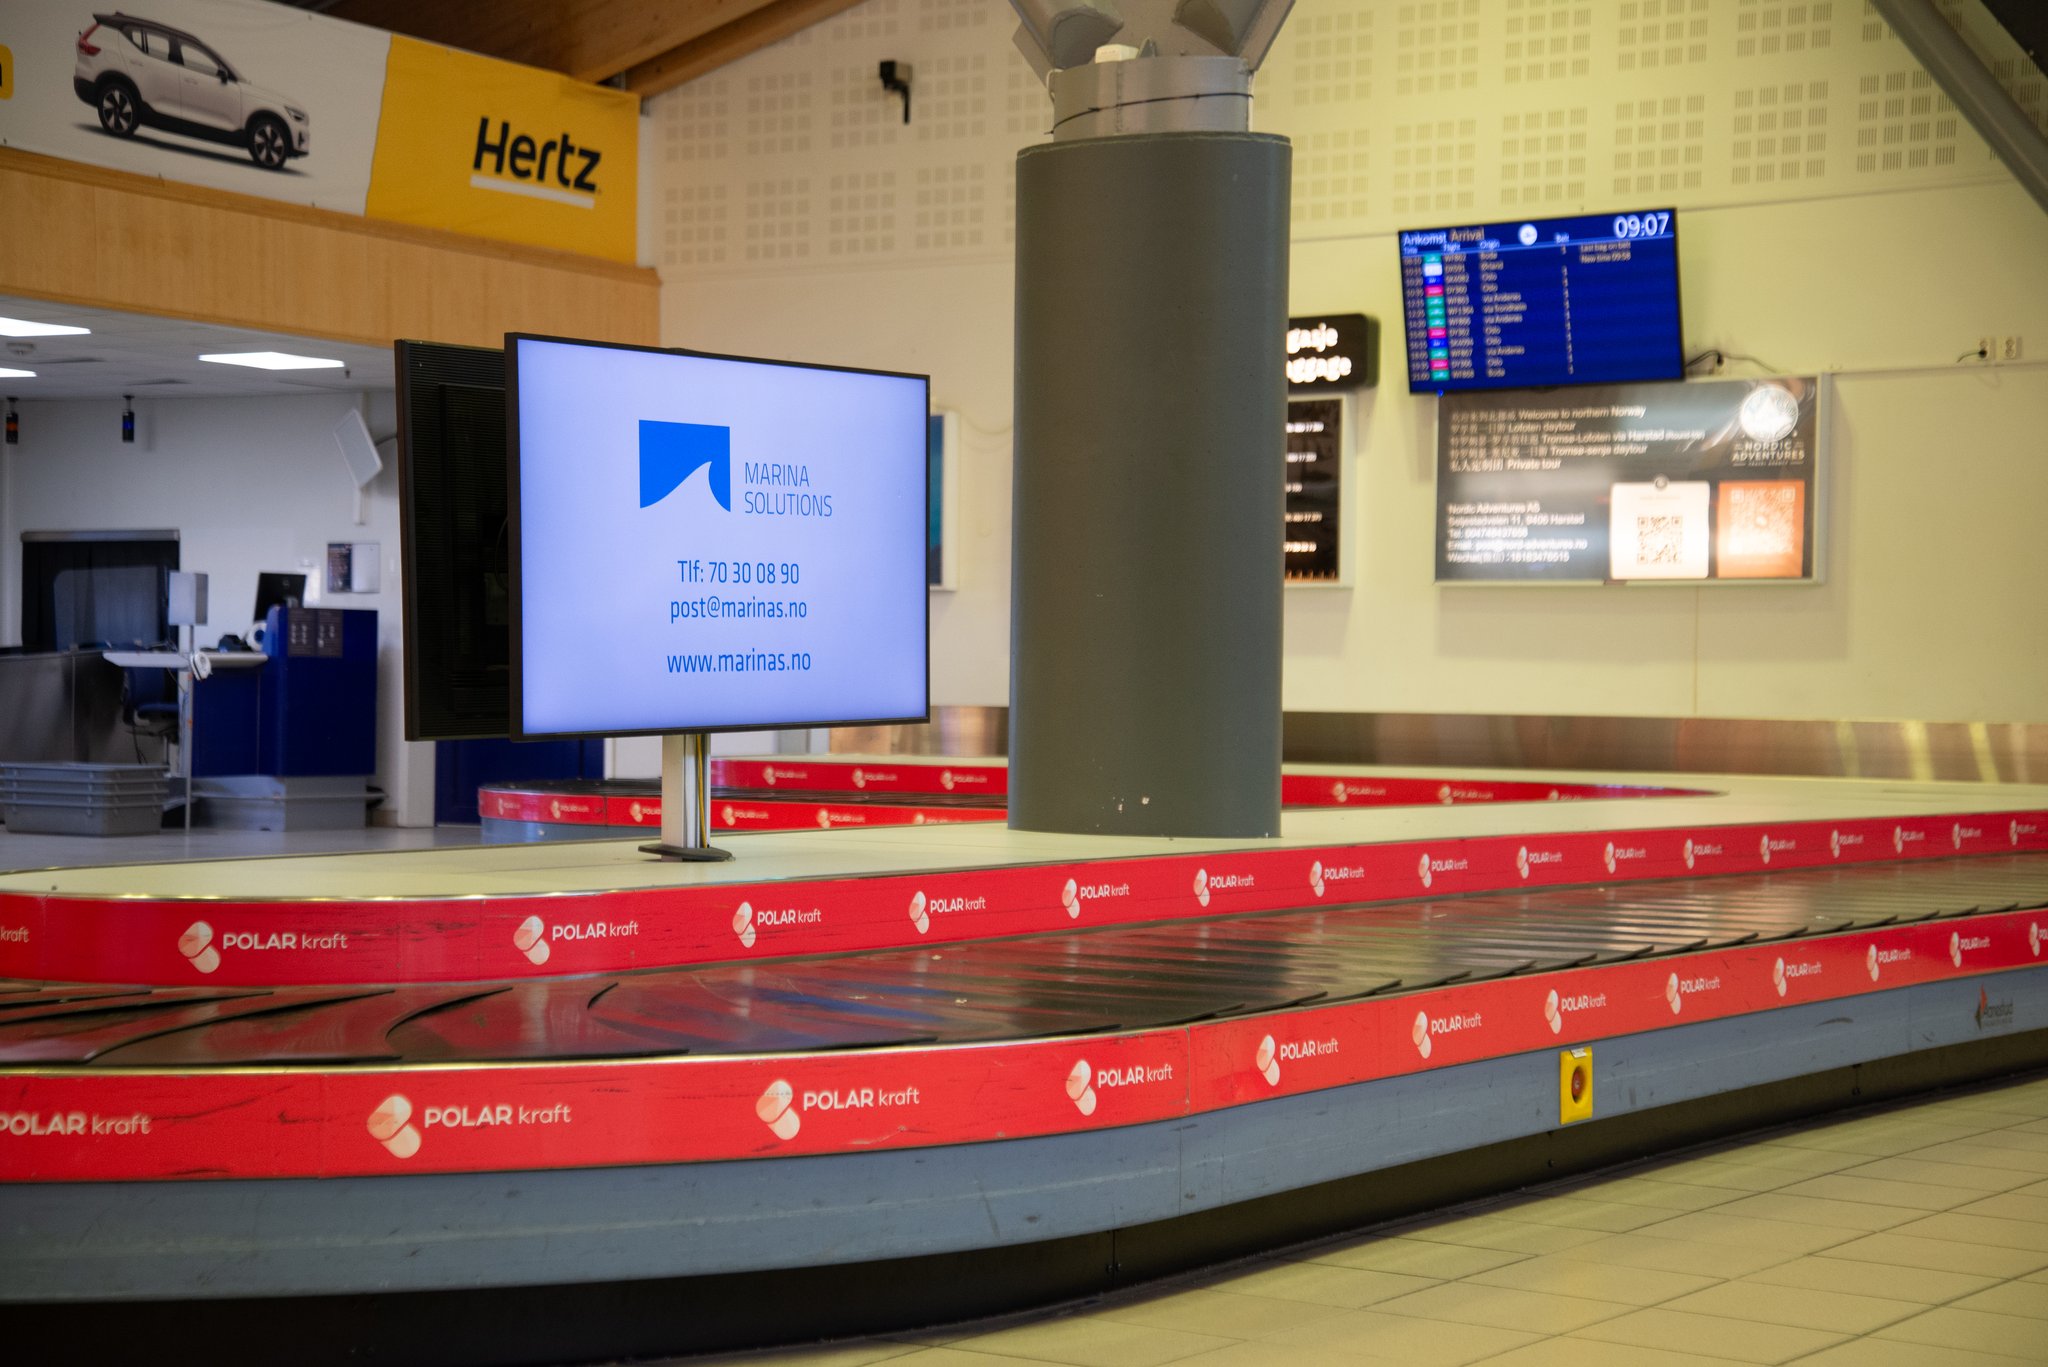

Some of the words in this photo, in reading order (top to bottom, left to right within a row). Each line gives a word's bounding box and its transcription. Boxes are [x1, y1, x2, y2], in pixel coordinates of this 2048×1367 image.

[473, 117, 602, 193] Hertz
[1614, 212, 1669, 239] 09:07
[1403, 231, 1447, 245] Ankomst
[1450, 226, 1485, 242] Arrival
[1518, 408, 1560, 420] Welcome
[1561, 408, 1571, 419] to
[1610, 405, 1646, 419] Norway
[1508, 421, 1541, 433] Lofoten
[1745, 440, 1792, 451] NORDIC
[1506, 459, 1541, 470] Private
[1541, 458, 1562, 470] tour
[1732, 449, 1805, 462] ADVENTURES
[745, 462, 809, 487] MARINA
[744, 491, 833, 517] SOLUTIONS
[1447, 502, 1476, 514] Nordic
[1477, 502, 1526, 514] Adventures
[708, 562, 727, 583] 70
[732, 562, 751, 583] 30
[756, 562, 776, 584] 08
[781, 563, 800, 584] 90
[670, 596, 807, 624] post@marinas.no
[667, 648, 811, 673] www.marinas.no
[1431, 859, 1454, 872] POLAR
[1528, 851, 1550, 864] POLAR
[1210, 875, 1237, 888] POLAR
[1237, 873, 1255, 887] kraft
[1324, 866, 1349, 880] POLAR
[1349, 866, 1365, 878] kraft
[1080, 885, 1111, 899] POLAR
[1111, 884, 1130, 897] kraft
[930, 898, 964, 913] POLAR
[965, 897, 986, 911] kraft
[757, 910, 796, 926] POLAR
[797, 908, 822, 924] kraft
[0, 926, 29, 943] kraft
[552, 923, 607, 941] POLAR
[609, 921, 639, 937] kraft
[222, 933, 297, 950] POLAR
[301, 933, 348, 950] kraft
[1878, 949, 1898, 964] POLAR
[1785, 963, 1807, 978] POLAR
[1807, 961, 1822, 975] kraft
[1680, 978, 1705, 994] POLAR
[1705, 976, 1720, 991] kraft
[1561, 995, 1589, 1012] POLAR
[1589, 993, 1606, 1009] kraft
[1431, 1016, 1462, 1035] POLAR
[1463, 1013, 1482, 1030] kraft
[1280, 1041, 1316, 1061] POLAR
[1317, 1038, 1338, 1056] kraft
[1097, 1066, 1145, 1088] POLAR
[1146, 1063, 1173, 1082] kraft
[803, 1089, 874, 1111] POLAR
[878, 1087, 920, 1106] kraft
[91, 1112, 152, 1136] kraft
[424, 1105, 512, 1129] POLAR
[517, 1104, 572, 1126] kraft
